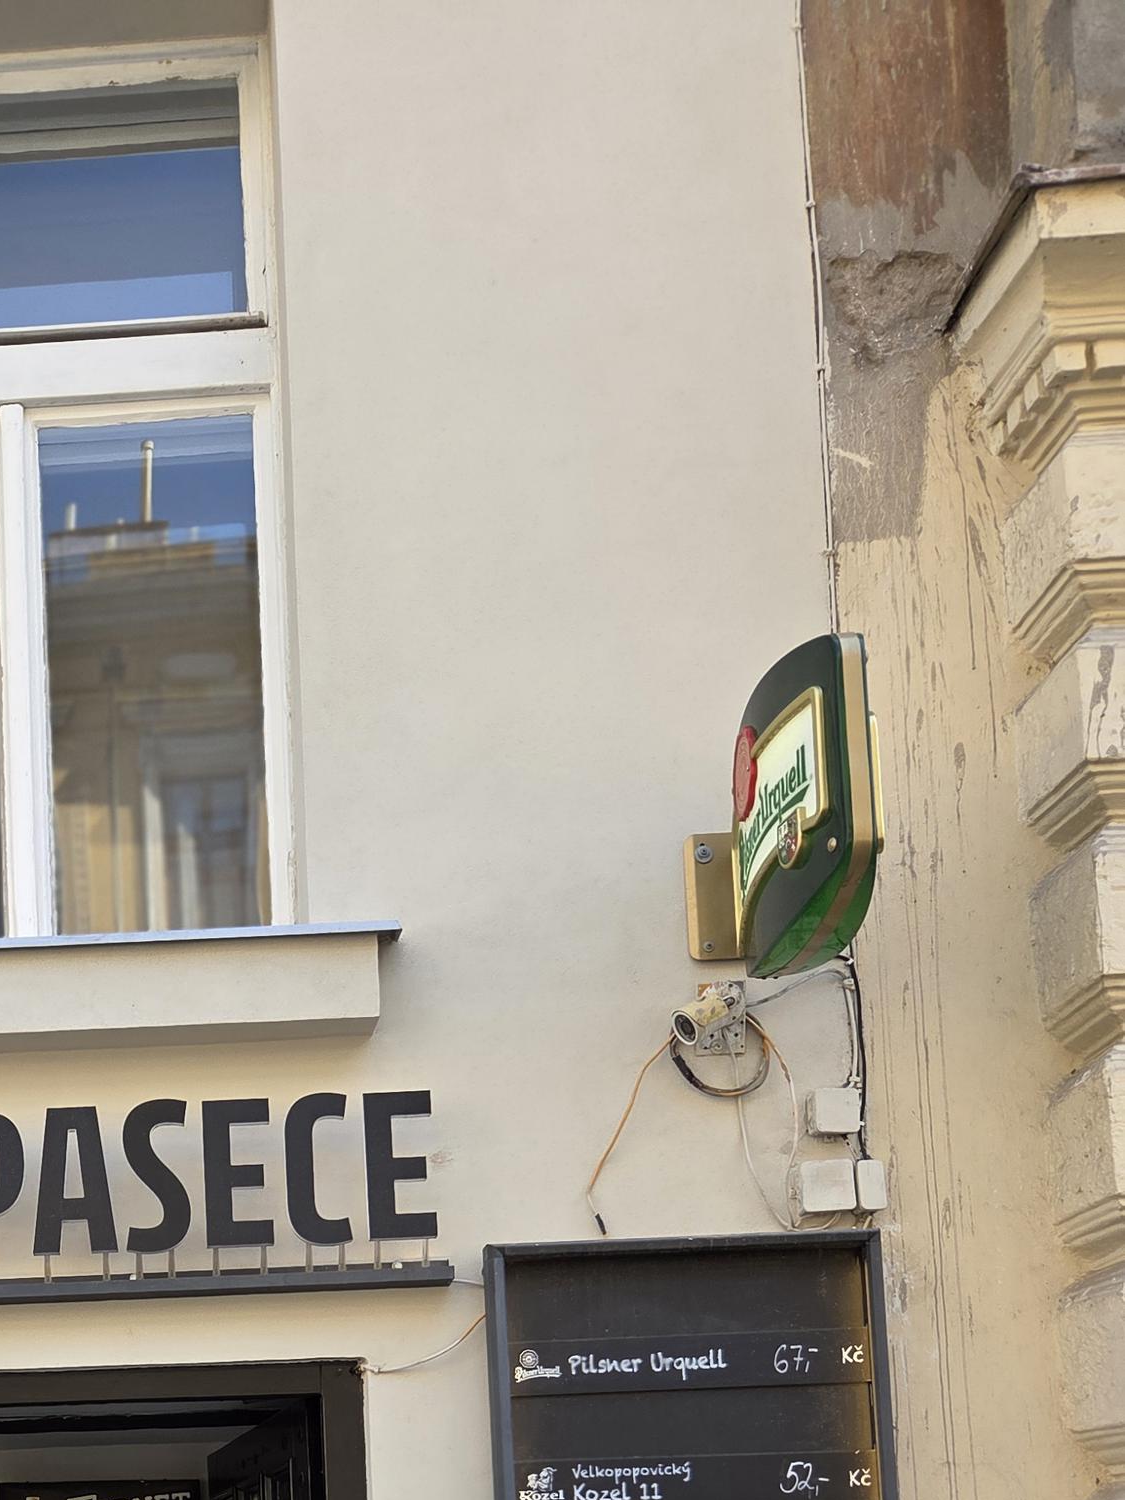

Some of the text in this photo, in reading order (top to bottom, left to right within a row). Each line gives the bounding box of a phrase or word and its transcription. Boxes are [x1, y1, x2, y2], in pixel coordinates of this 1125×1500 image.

[759, 744, 808, 827] Urquell
[567, 1343, 865, 1381] Pilsner Urquell 67,- Kč
[572, 1461, 691, 1484] Velkopopovický
[639, 1483, 663, 1500] 11
[849, 1468, 872, 1488] Kč
